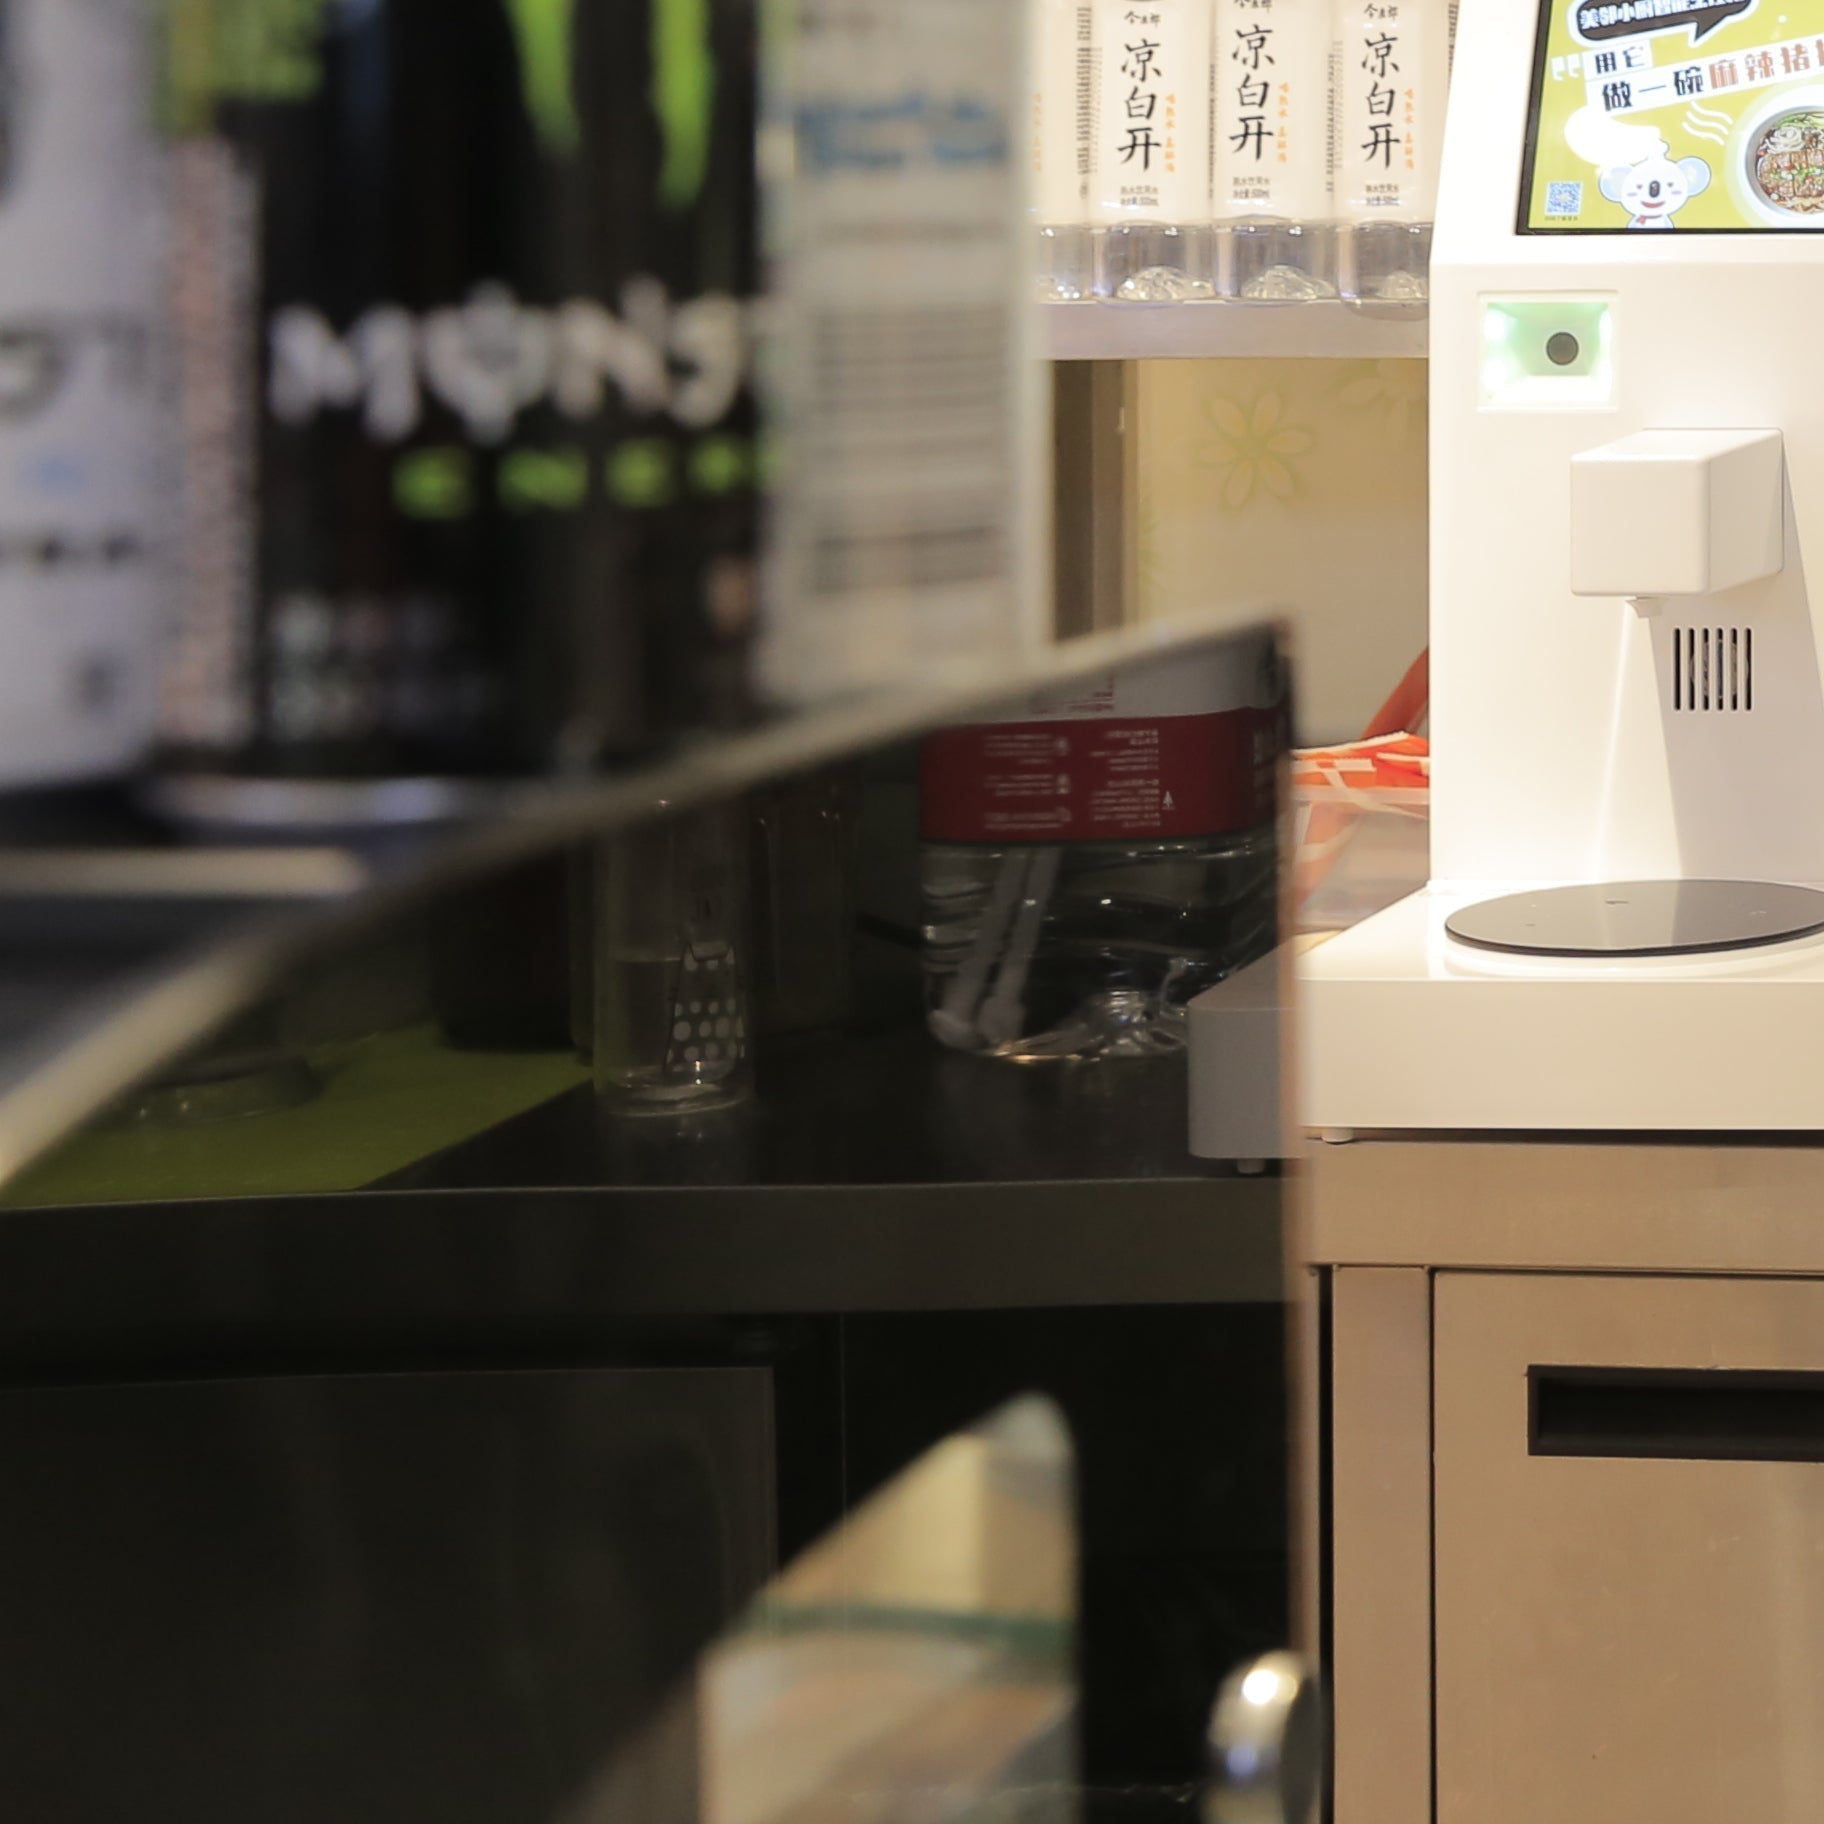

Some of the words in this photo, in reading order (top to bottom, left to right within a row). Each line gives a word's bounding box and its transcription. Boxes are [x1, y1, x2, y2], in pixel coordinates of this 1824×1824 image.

[1117, 38, 1163, 171] 凉白开
[1228, 24, 1274, 162] 凉白开
[1361, 32, 1400, 169] 凉白开
[1595, 46, 1645, 74] 用它
